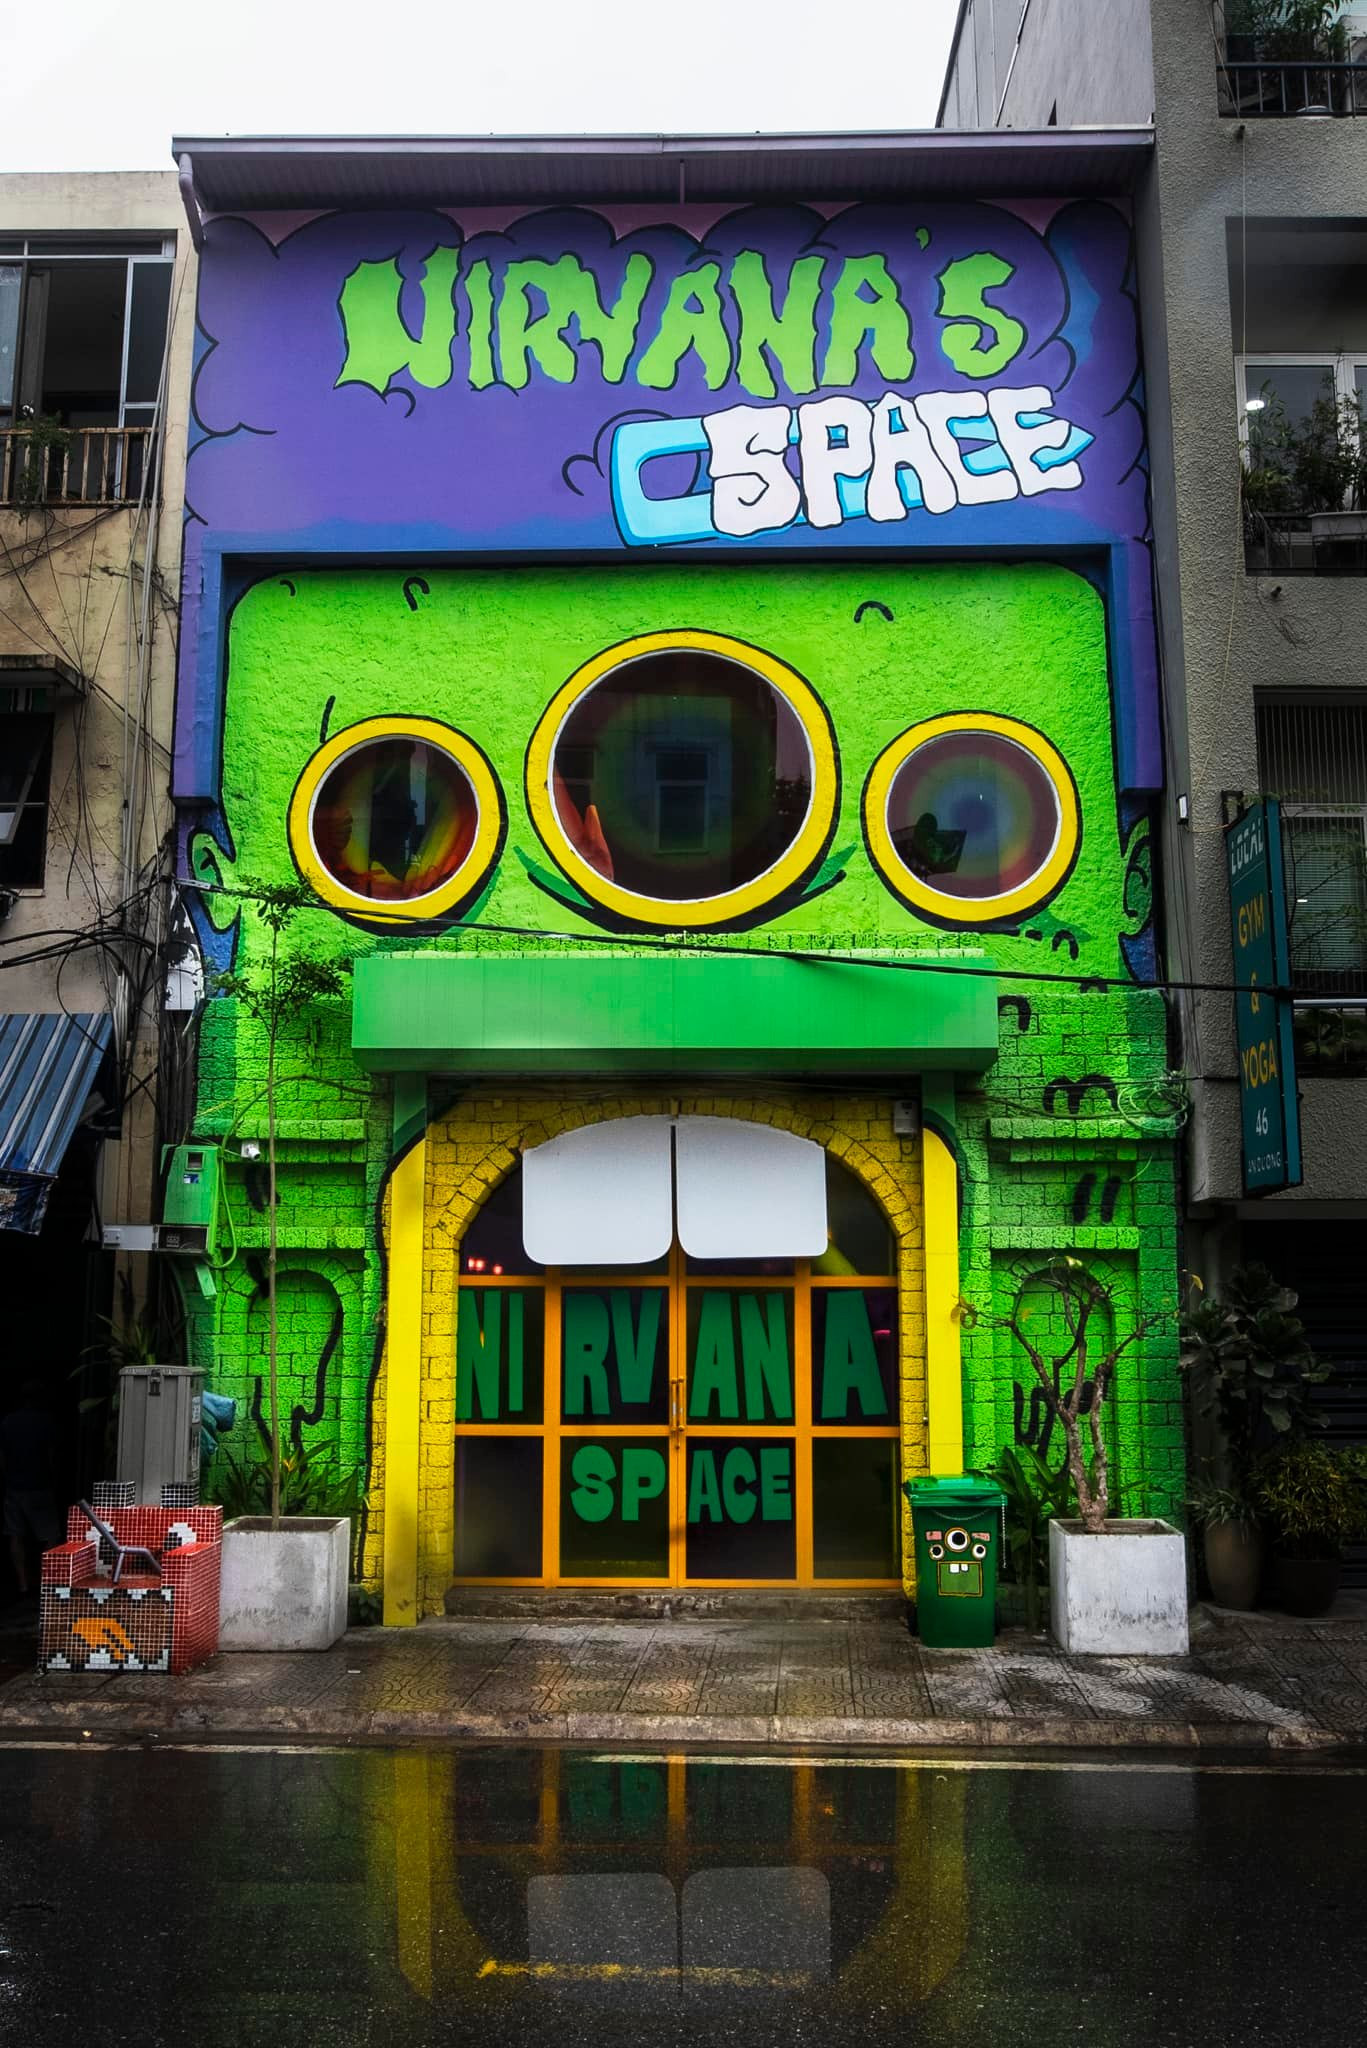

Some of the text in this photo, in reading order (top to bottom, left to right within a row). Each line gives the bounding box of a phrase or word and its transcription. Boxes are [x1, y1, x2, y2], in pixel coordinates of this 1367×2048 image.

[334, 227, 1026, 398] NIRVANA'S
[702, 385, 1086, 538] SPACE
[1231, 817, 1264, 876] LOCAL
[1238, 893, 1265, 948] GYM
[1251, 971, 1260, 1015] &
[1242, 1039, 1278, 1091] YOGA
[1256, 1106, 1269, 1136] 46
[570, 1445, 793, 1524] SPACE
